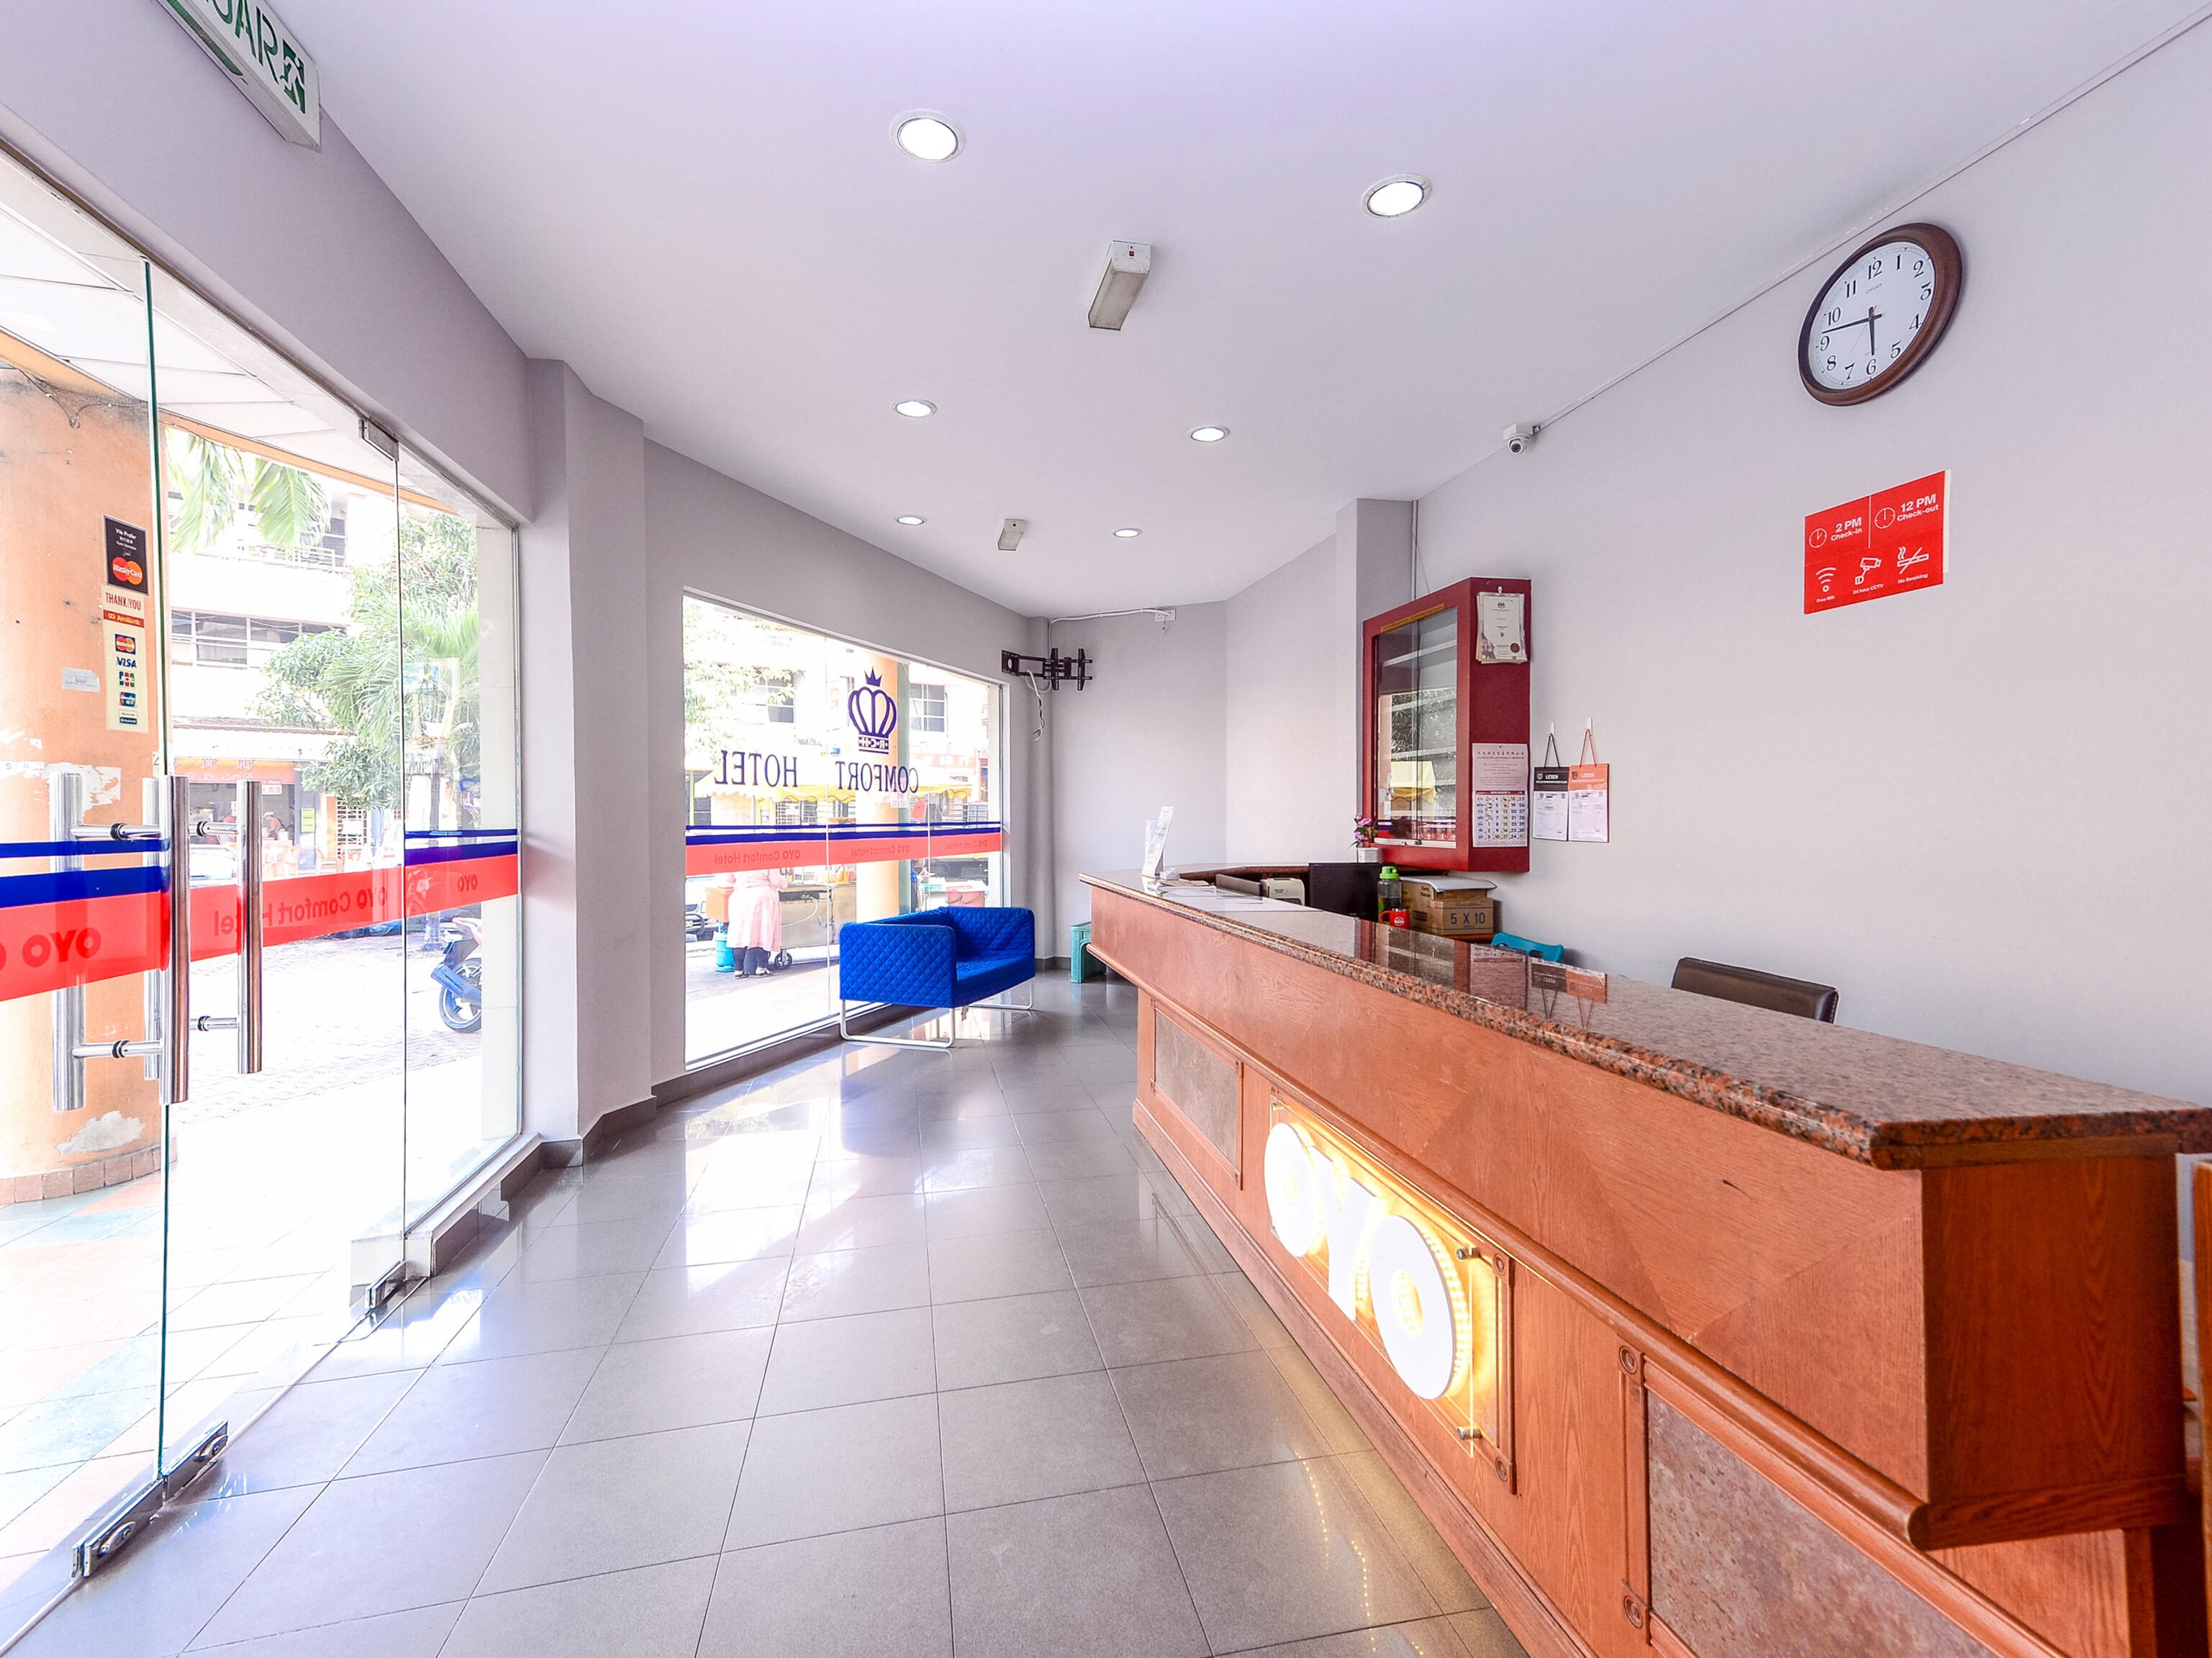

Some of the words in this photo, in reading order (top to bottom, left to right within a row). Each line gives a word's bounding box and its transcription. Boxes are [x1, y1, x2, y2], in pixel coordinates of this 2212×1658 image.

[1868, 260, 1882, 281] 12
[1896, 254, 1901, 271] 1
[1913, 260, 1924, 278] 2
[1846, 279, 1857, 298] 11
[1921, 281, 1932, 301] 3
[1828, 307, 1841, 325] 10
[1909, 313, 1922, 330] 4
[1820, 336, 1830, 351] 9
[1890, 340, 1901, 359] 5
[1826, 355, 1836, 371] 8
[1845, 363, 1855, 380] 7
[1866, 358, 1877, 375] 6
[1900, 501, 1914, 513] 12
[1916, 494, 1936, 509] PM
[1897, 504, 1939, 522] Check-out
[1835, 523, 1843, 533] 2
[1844, 517, 1862, 531] PM
[1831, 527, 1862, 541] Check-in
[112, 564, 143, 578] MasterCard
[1906, 573, 1928, 583] Smoking
[105, 592, 127, 607] THANK
[129, 599, 142, 610] YOU
[116, 656, 137, 669] VISA
[1451, 912, 1457, 925] 5
[1474, 912, 1485, 924] 10
[1264, 1122, 1456, 1400] OYO
